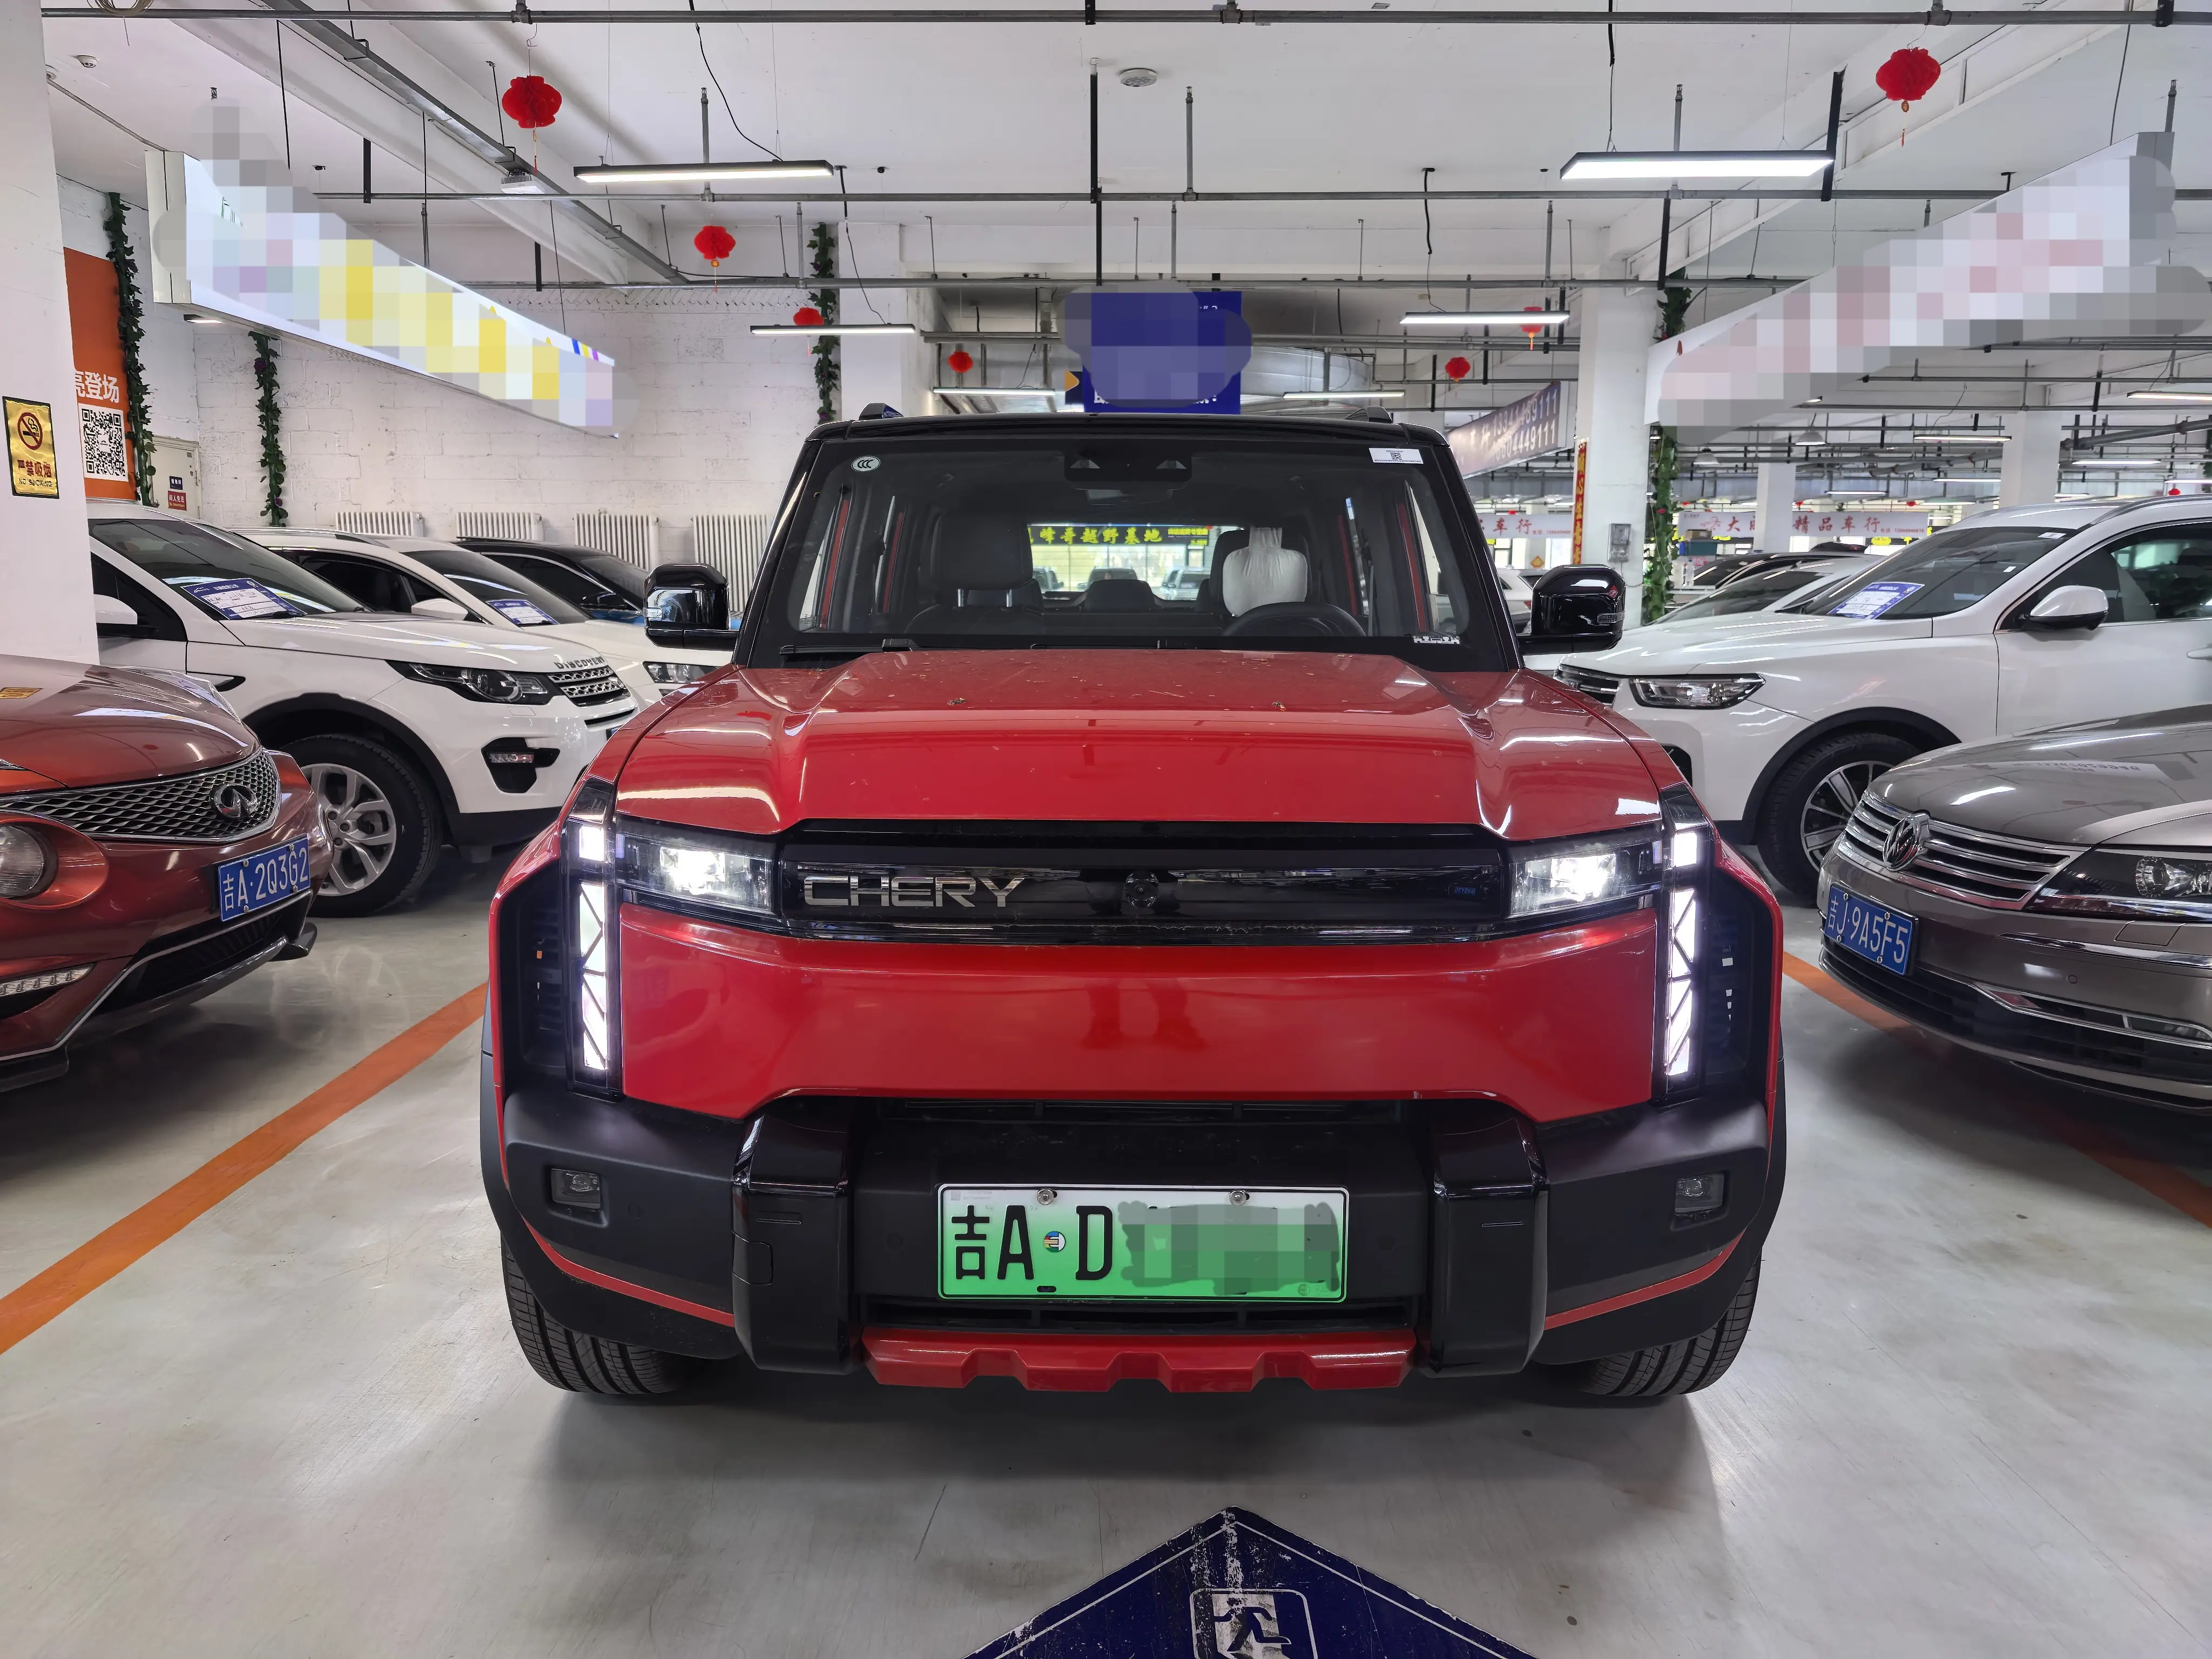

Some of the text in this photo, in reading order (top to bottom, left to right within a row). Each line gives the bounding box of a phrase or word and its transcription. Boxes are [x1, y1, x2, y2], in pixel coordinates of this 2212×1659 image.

[1028, 527, 1162, 545] 峰哥越野基地
[554, 656, 605, 670] DISCOVERY
[804, 876, 1025, 908] CHERY
